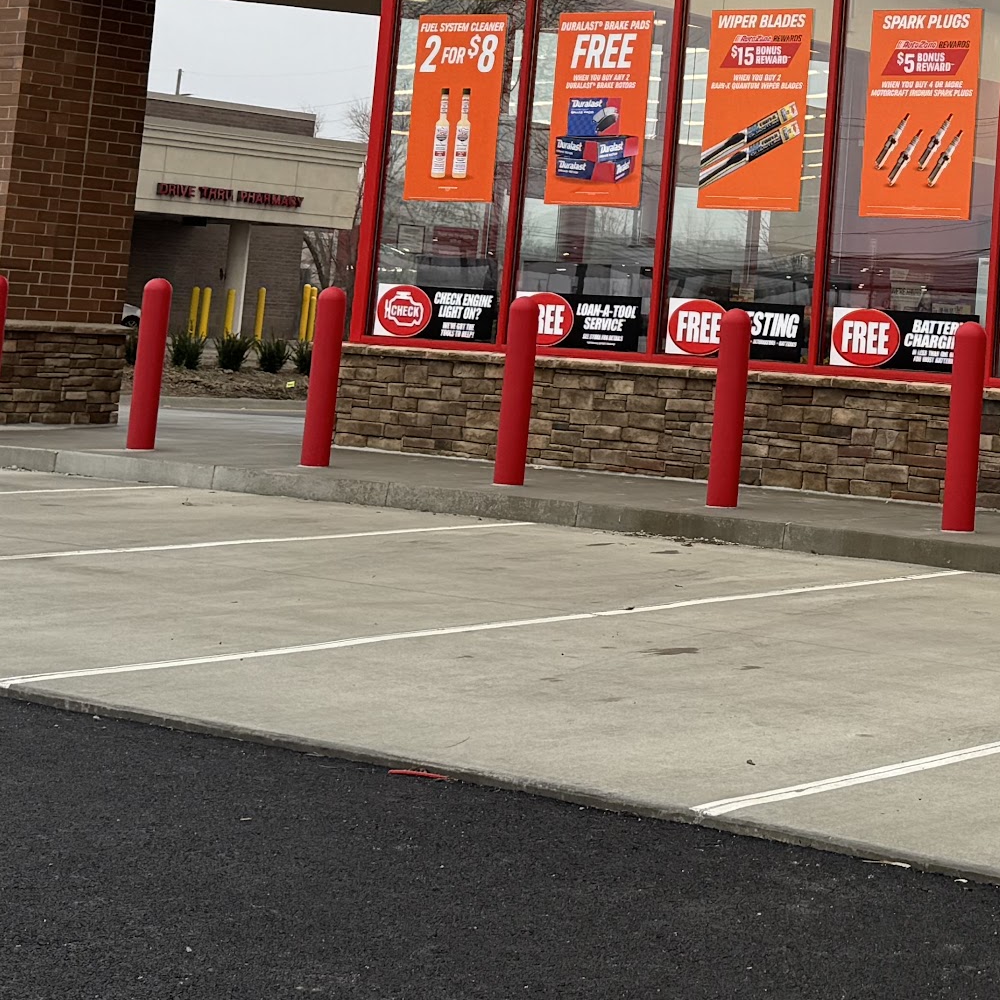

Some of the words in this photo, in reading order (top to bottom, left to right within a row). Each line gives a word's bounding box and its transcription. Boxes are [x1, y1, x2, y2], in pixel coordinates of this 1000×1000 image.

[420, 23, 439, 32] FUEL
[439, 22, 470, 32] SYSTEM
[470, 22, 505, 32] CLEANER
[604, 20, 629, 30] BRAKE
[630, 20, 651, 30] PADS
[718, 15, 758, 29] WIPER
[759, 14, 806, 28] BLADES
[882, 14, 926, 30] SPARK
[927, 14, 971, 29] PLUGS
[570, 33, 638, 69] FREE
[755, 46, 782, 55] BONUS
[938, 40, 970, 48] REWARDS
[419, 34, 442, 72] 2
[441, 47, 467, 64] FOR
[467, 34, 499, 73] $8
[731, 45, 755, 66] $15
[917, 52, 945, 62] BONUS
[897, 52, 915, 73] $5
[761, 82, 780, 90] WIPER
[781, 82, 803, 90] BLADES
[882, 80, 900, 88] WHEN
[901, 80, 914, 88] YOU
[933, 89, 953, 97] SPARK
[953, 89, 973, 97] PLUGS
[571, 99, 603, 108] Duralast
[557, 139, 583, 152] Duralast
[600, 141, 624, 154] Duralast
[558, 160, 587, 171] Duralast
[157, 183, 197, 198] DRIVE
[199, 186, 234, 201] THRU
[237, 190, 304, 208] PHARMACY
[434, 291, 463, 306] CHECK
[462, 293, 494, 308] ENGINE
[391, 304, 420, 317] CHECK
[438, 305, 464, 319] LIGHT
[463, 306, 482, 320] ON?
[576, 303, 637, 319] LOAN-A-TOOL
[537, 303, 565, 336] REE
[583, 317, 625, 331] SERVICE
[676, 310, 722, 344] FREE
[745, 310, 800, 339] STING
[912, 319, 962, 335] BATTER
[841, 320, 891, 356] FREE
[904, 333, 955, 350] CHARGI
